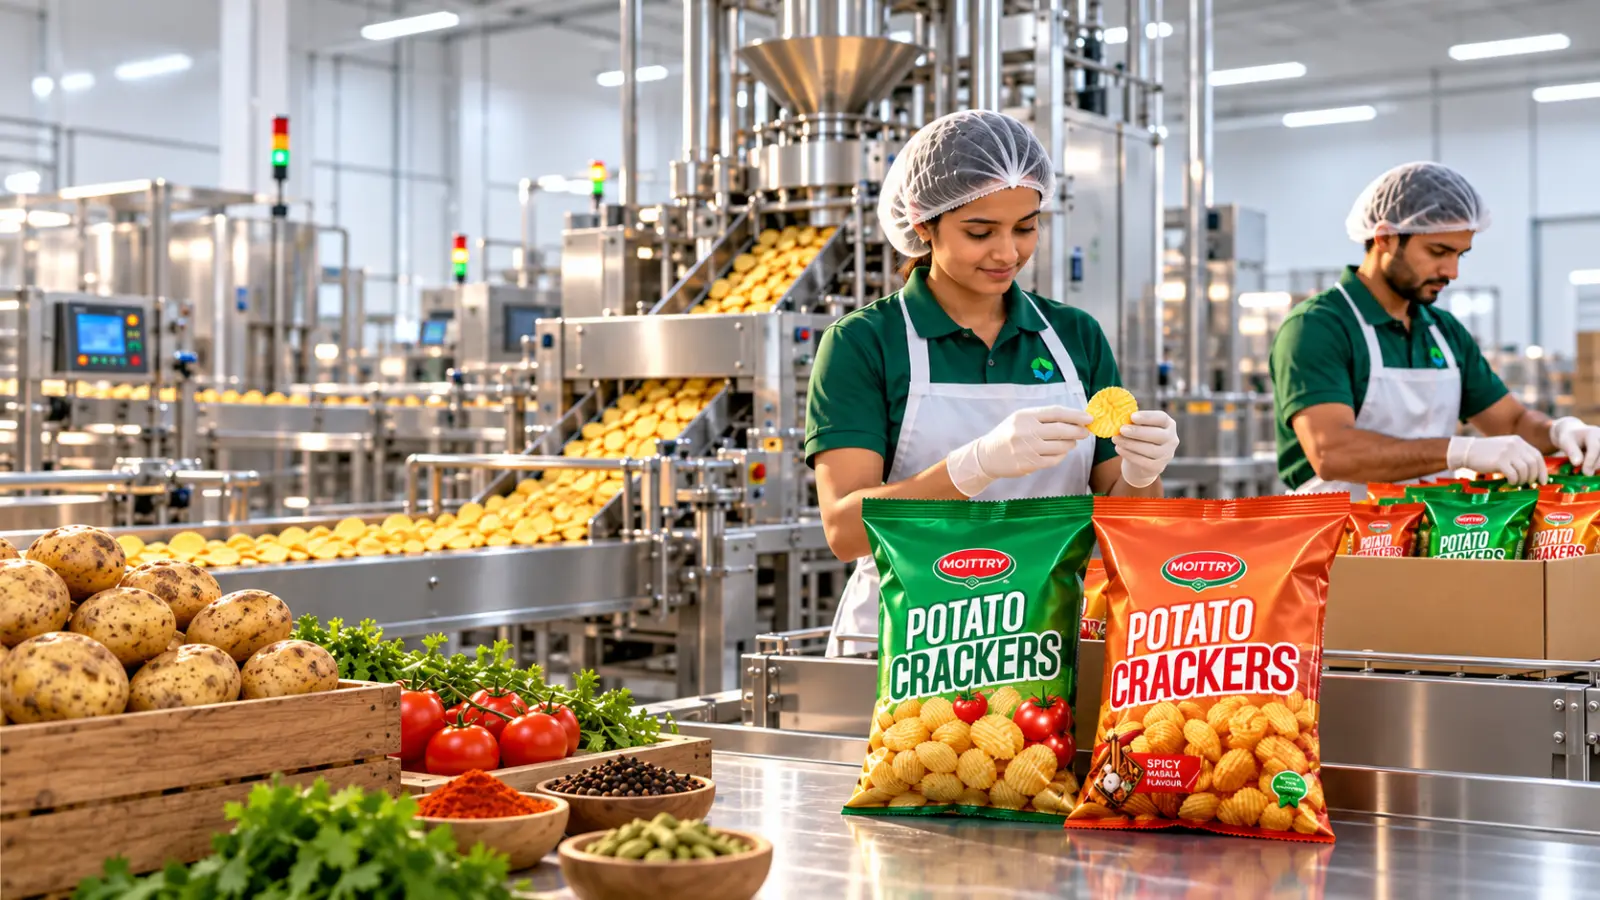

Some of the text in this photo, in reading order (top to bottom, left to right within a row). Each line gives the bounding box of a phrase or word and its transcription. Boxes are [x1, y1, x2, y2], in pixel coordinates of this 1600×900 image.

[1360, 534, 1392, 551] POTATO
[1440, 531, 1489, 553] POTATO
[1533, 528, 1574, 550] POTATO
[942, 558, 1007, 570] MOITTRY
[1170, 560, 1237, 572] MOITTRY
[906, 591, 1025, 650] POTATO
[1127, 598, 1254, 656] POTATO
[889, 631, 1061, 700] CRACKERS
[1111, 643, 1297, 710] CRACKERS
[1147, 758, 1181, 769] SPICY
[1147, 769, 1181, 778] MASALA
[1147, 778, 1183, 787] FLAVOUR
